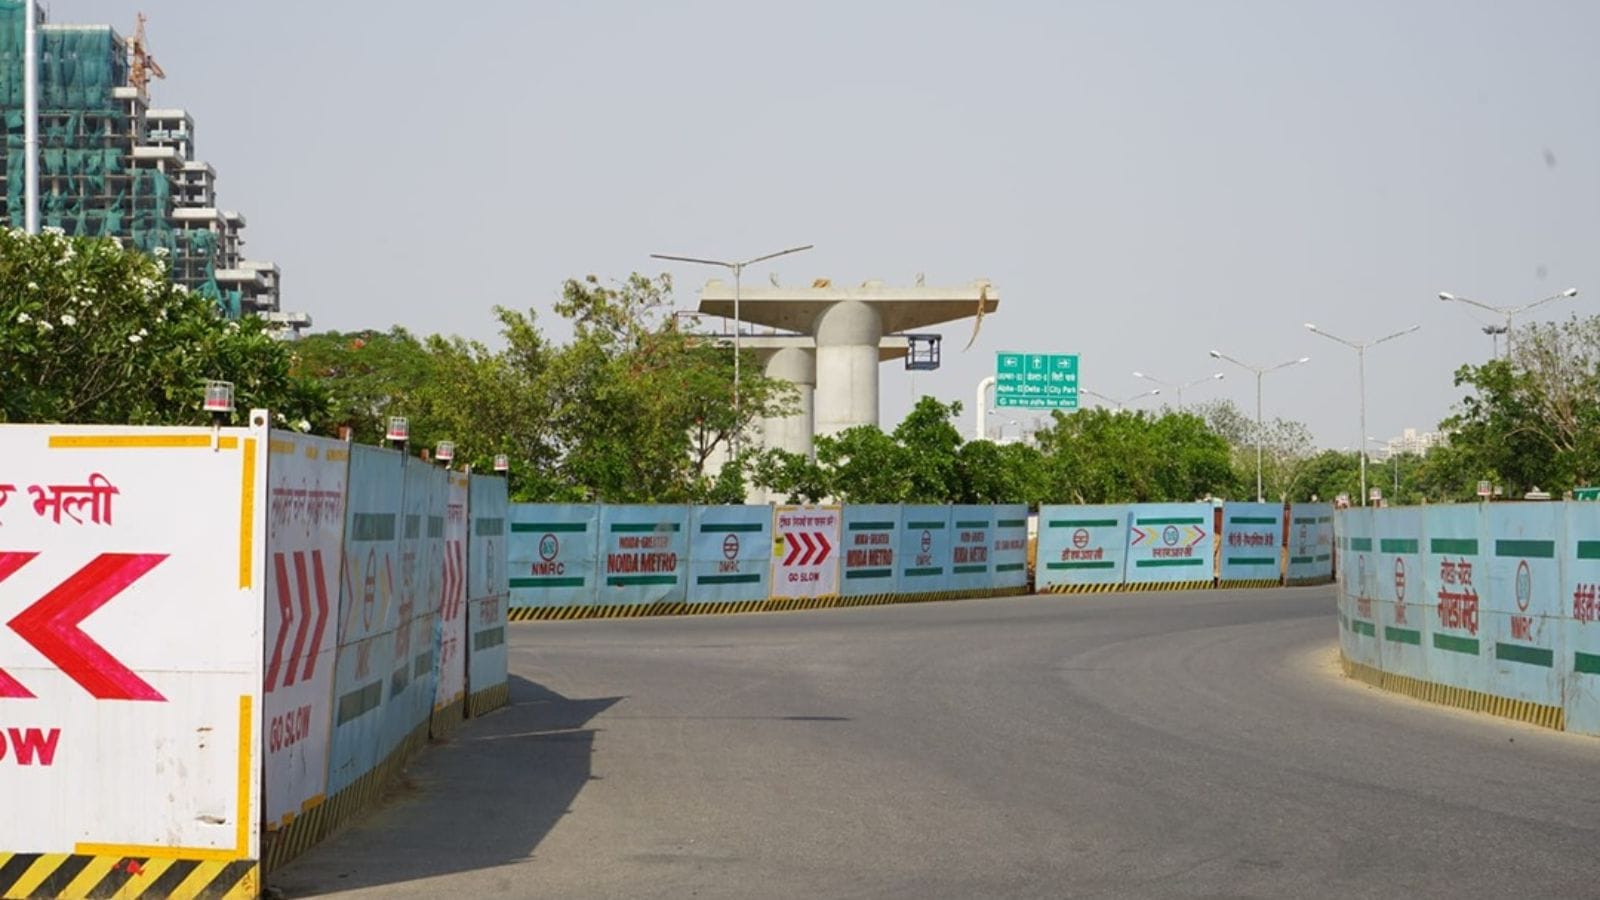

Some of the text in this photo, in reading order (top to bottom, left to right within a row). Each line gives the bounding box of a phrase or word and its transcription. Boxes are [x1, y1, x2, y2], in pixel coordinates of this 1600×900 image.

[1048, 385, 1076, 394] City Park
[28, 471, 120, 525] भली
[607, 551, 677, 574] NOIDA METRO
[847, 548, 893, 567] NOIDA METRO
[531, 562, 565, 576] NMRC
[788, 572, 820, 582] GO SLOW
[270, 704, 312, 754] GO SLOW
